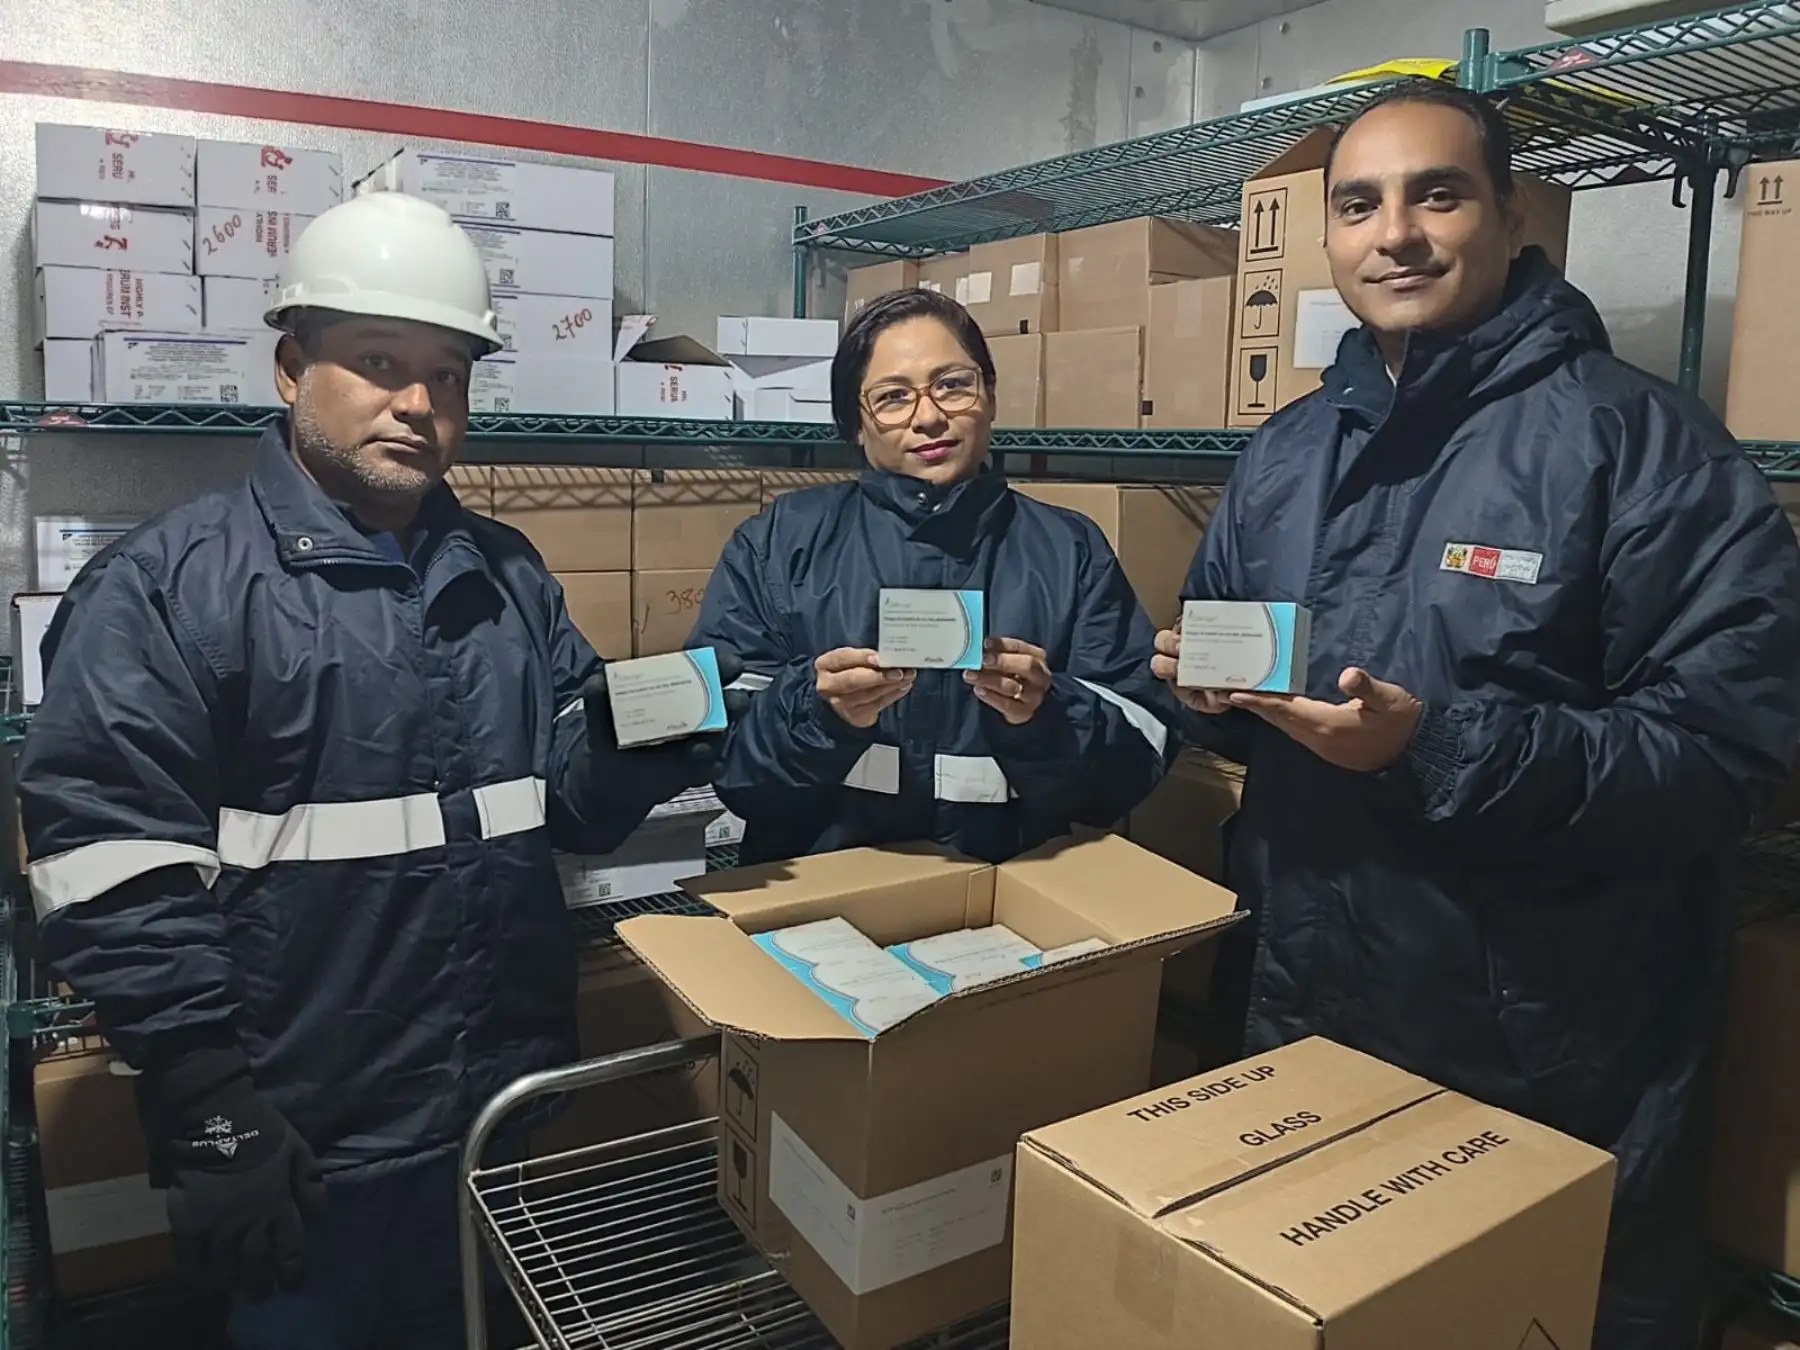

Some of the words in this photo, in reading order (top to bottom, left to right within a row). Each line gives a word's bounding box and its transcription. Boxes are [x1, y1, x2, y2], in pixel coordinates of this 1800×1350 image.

[202, 213, 242, 256] 2600
[551, 307, 593, 342] 2700
[1126, 1096, 1190, 1124] THIS
[1194, 1075, 1247, 1104] SIDE
[1241, 1065, 1277, 1085] UP
[1239, 1110, 1323, 1148] GLASS
[1279, 1188, 1392, 1248] HANDLE
[1381, 1159, 1452, 1196] WITH
[1442, 1129, 1512, 1166] CARE
